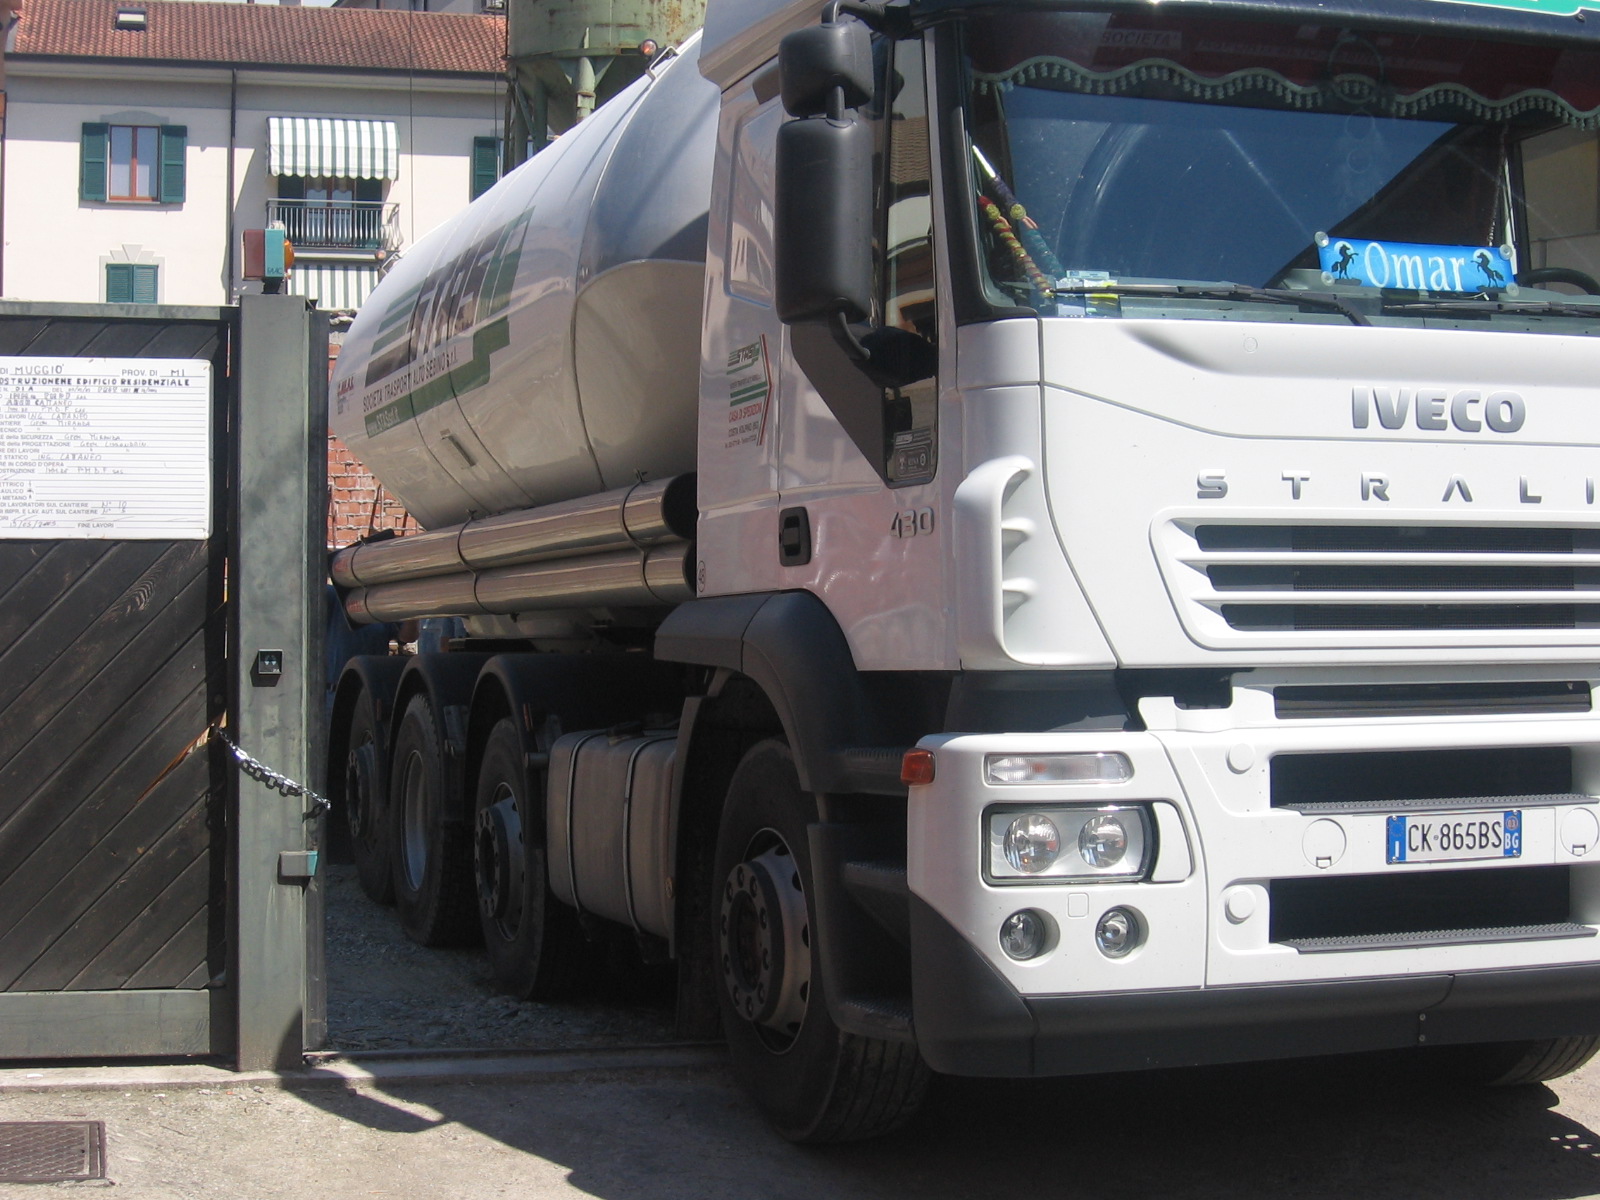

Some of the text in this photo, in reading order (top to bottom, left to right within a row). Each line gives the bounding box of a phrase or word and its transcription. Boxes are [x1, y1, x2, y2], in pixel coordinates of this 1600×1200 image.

[1362, 240, 1467, 292] Omar
[121, 369, 147, 377] PROV.
[170, 369, 186, 377] MI
[76, 378, 118, 386] EDIFICIO
[120, 378, 190, 387] RESIDENZIALE
[1352, 386, 1526, 432] IVECO
[60, 501, 89, 509] CANTIERE
[68, 508, 99, 516] CANTIERE
[891, 507, 934, 538] 430
[1505, 833, 1519, 849] BG
